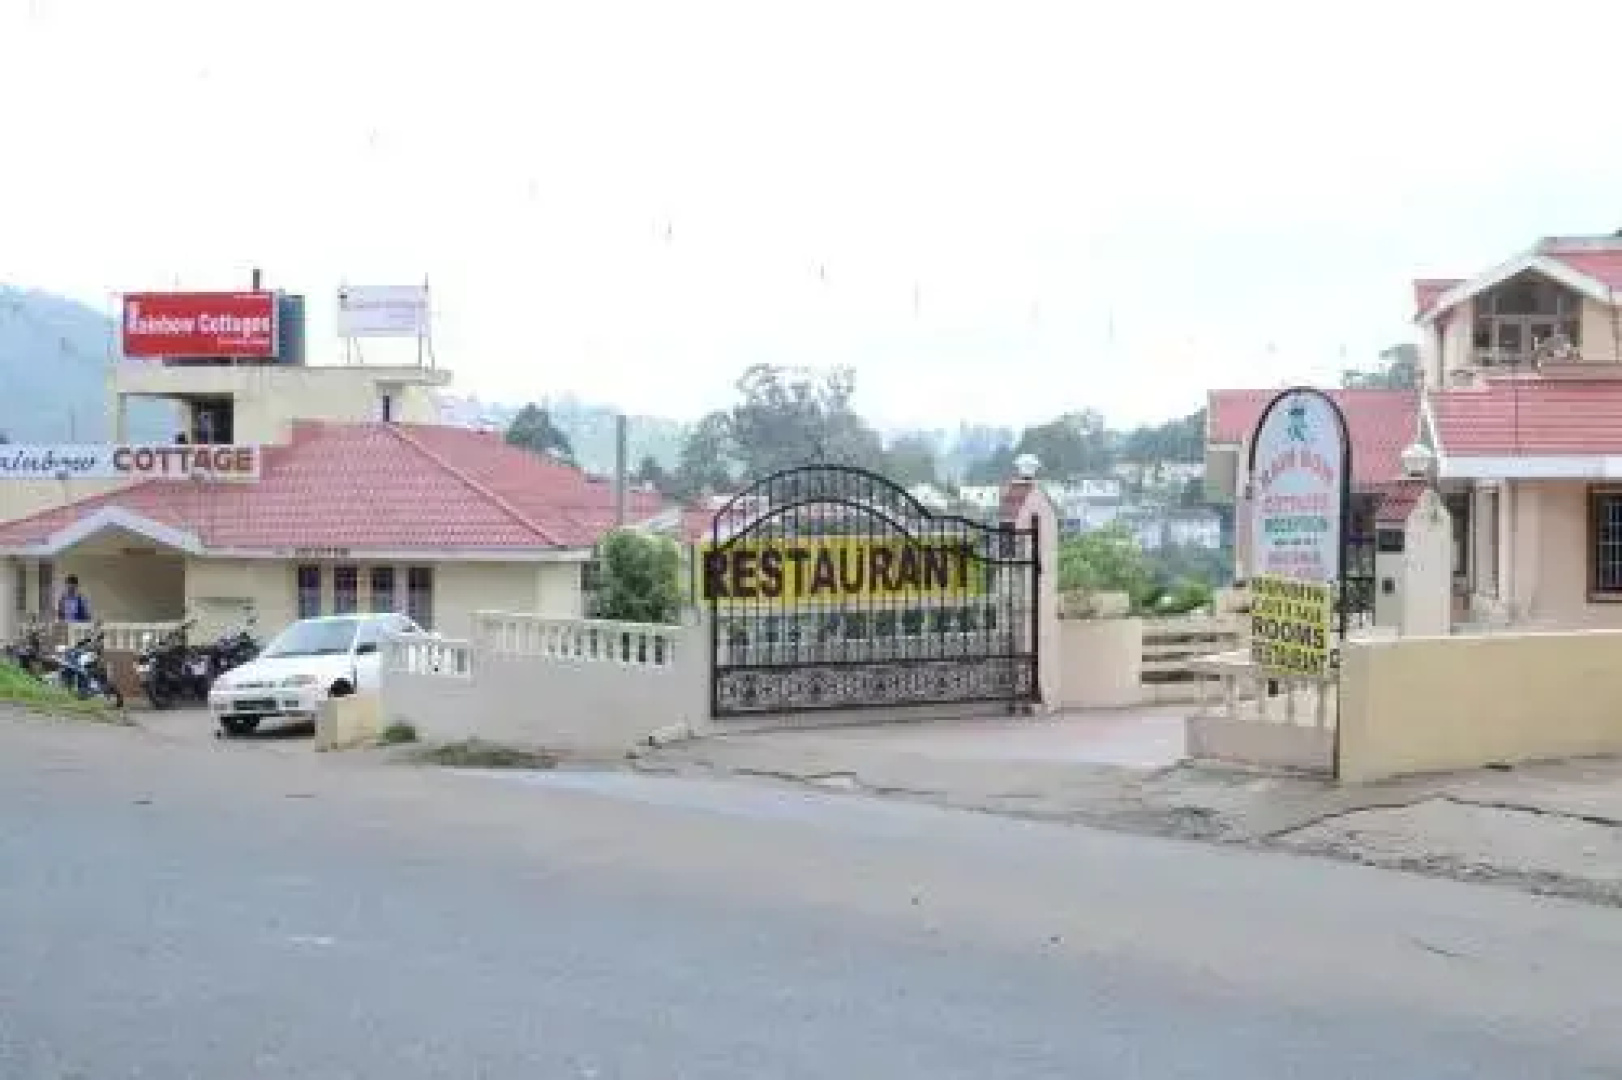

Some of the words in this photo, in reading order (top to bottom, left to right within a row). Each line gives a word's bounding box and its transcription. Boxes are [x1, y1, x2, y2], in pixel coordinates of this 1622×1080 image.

[198, 313, 270, 338] Cottages
[113, 447, 253, 472] COTTAGE
[703, 544, 974, 600] RESTAURANT
[1252, 616, 1325, 650] ROOMS
